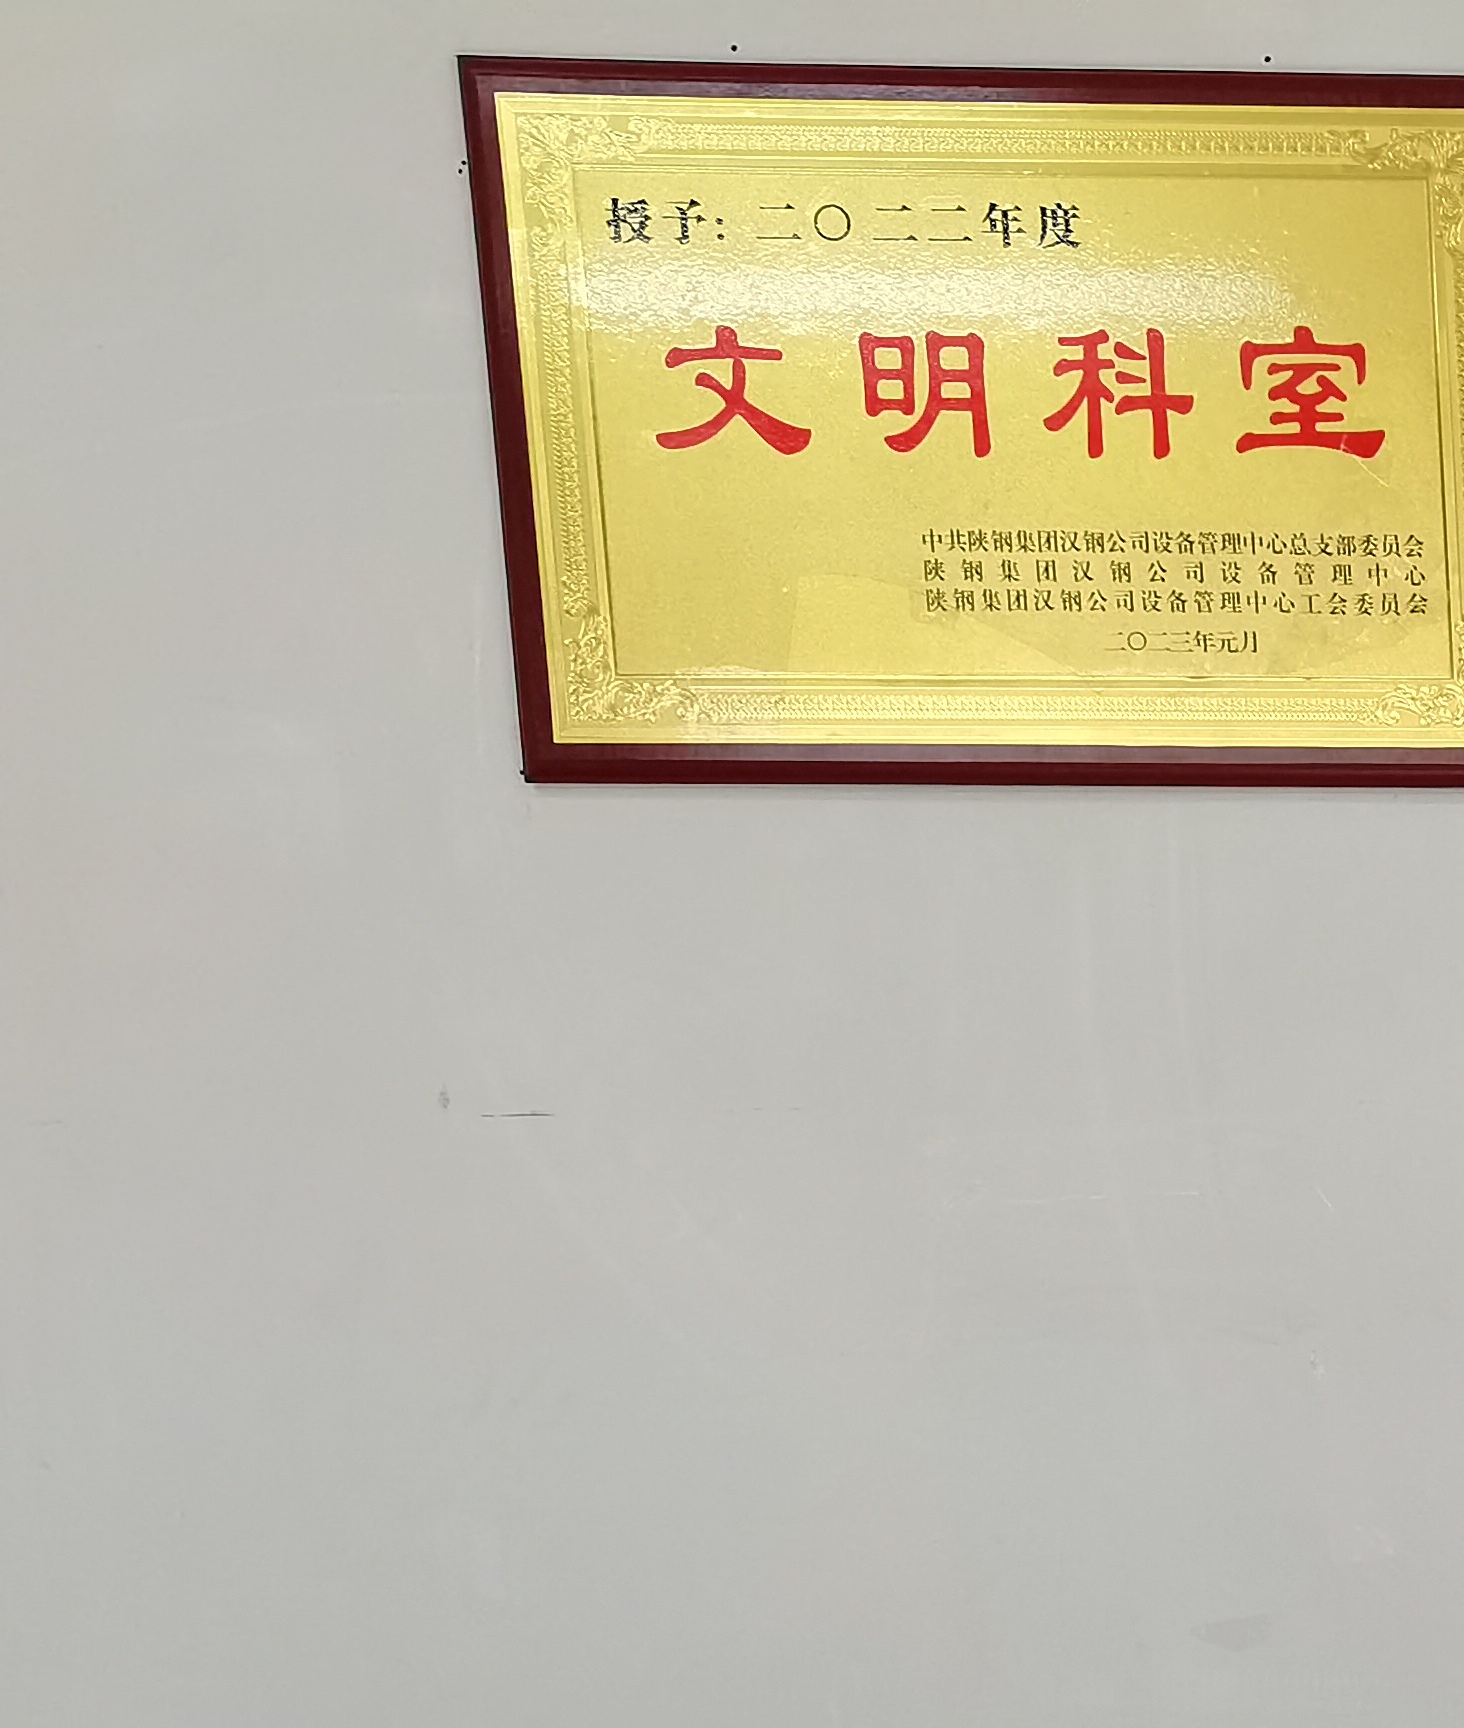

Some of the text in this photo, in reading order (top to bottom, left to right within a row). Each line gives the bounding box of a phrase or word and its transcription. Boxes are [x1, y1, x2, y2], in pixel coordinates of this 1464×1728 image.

[655, 324, 1387, 459] 文明科室
[920, 526, 1426, 560] 中共陕钢集团汉钢公司设备管理中心总支部委员会
[922, 556, 1427, 585] 陕钢集团汉钢公司设备管理中心
[924, 586, 1430, 617] 陕钢集团汉钢公司设备管理中心工会委员会
[1103, 630, 1259, 654] 二〇二三年元月
